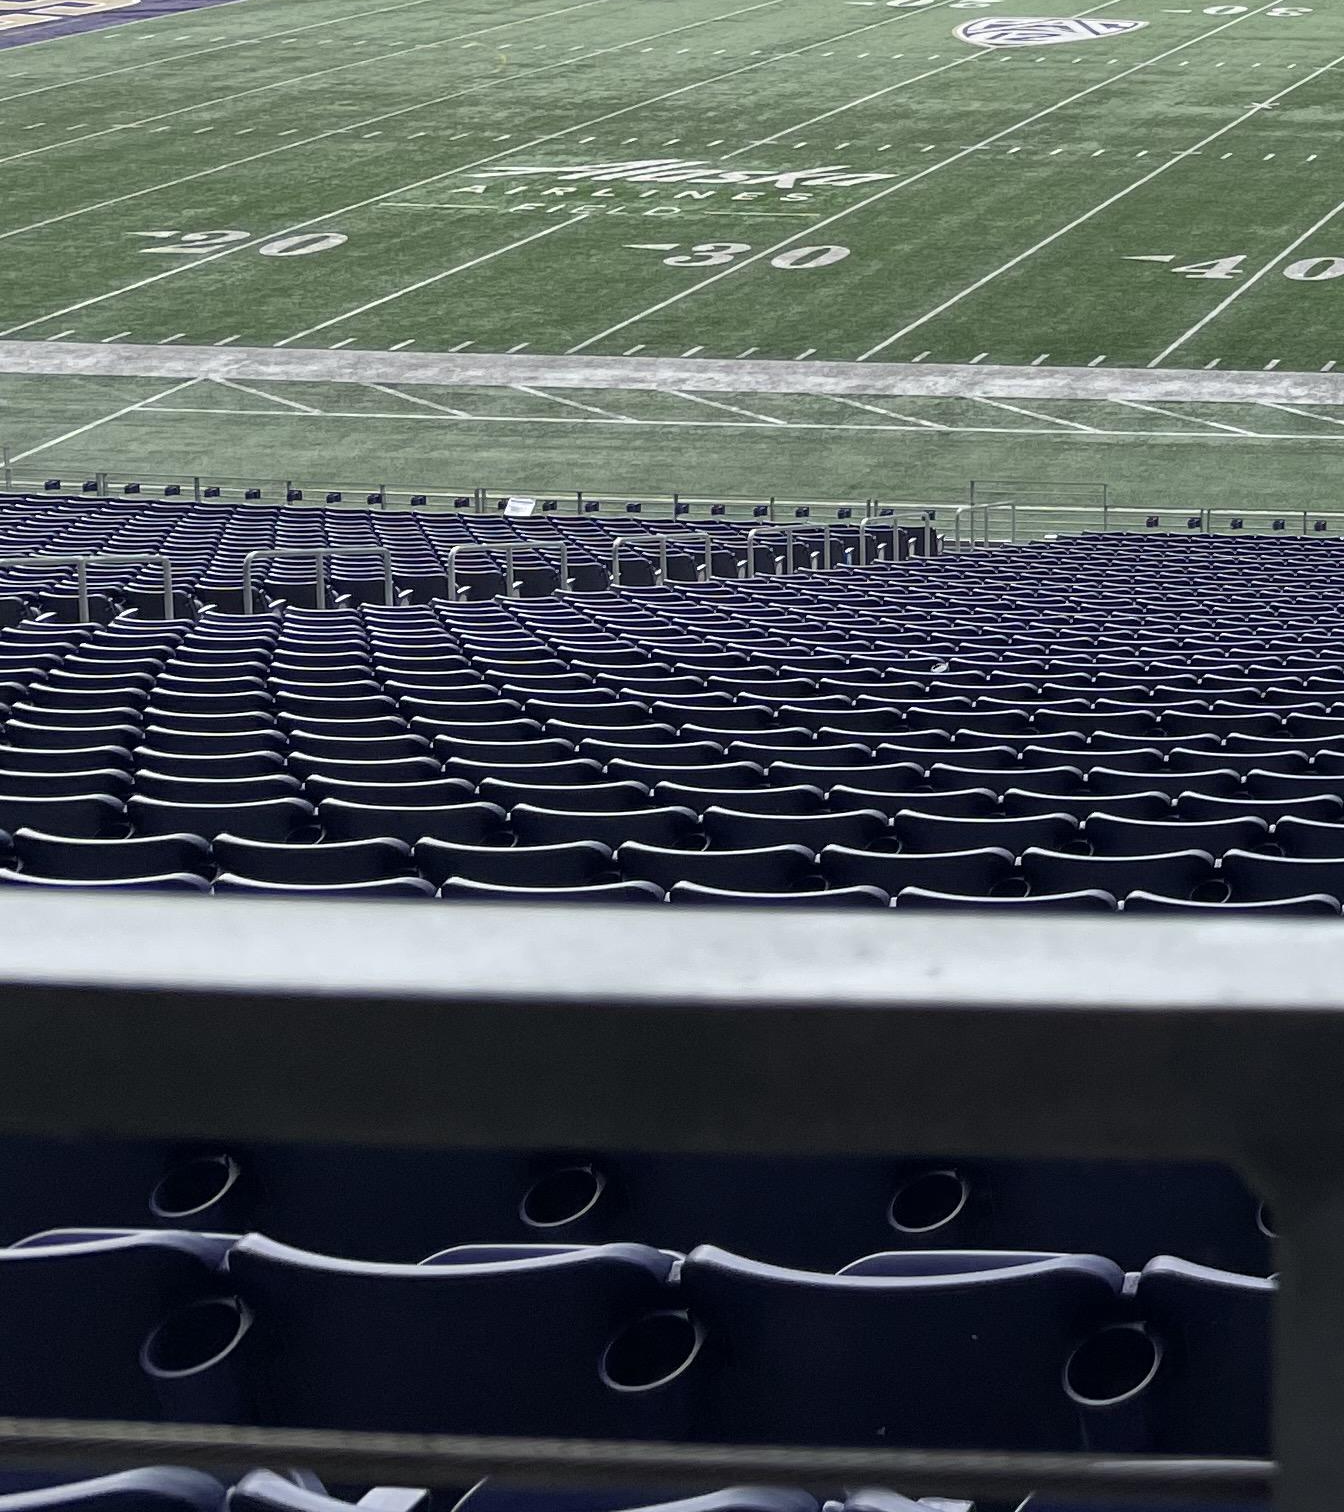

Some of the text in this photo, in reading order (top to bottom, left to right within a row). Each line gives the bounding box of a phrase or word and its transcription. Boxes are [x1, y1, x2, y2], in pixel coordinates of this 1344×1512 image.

[459, 158, 900, 190] Alaska
[450, 184, 815, 203] AIRLINES
[508, 202, 682, 217] FIELD
